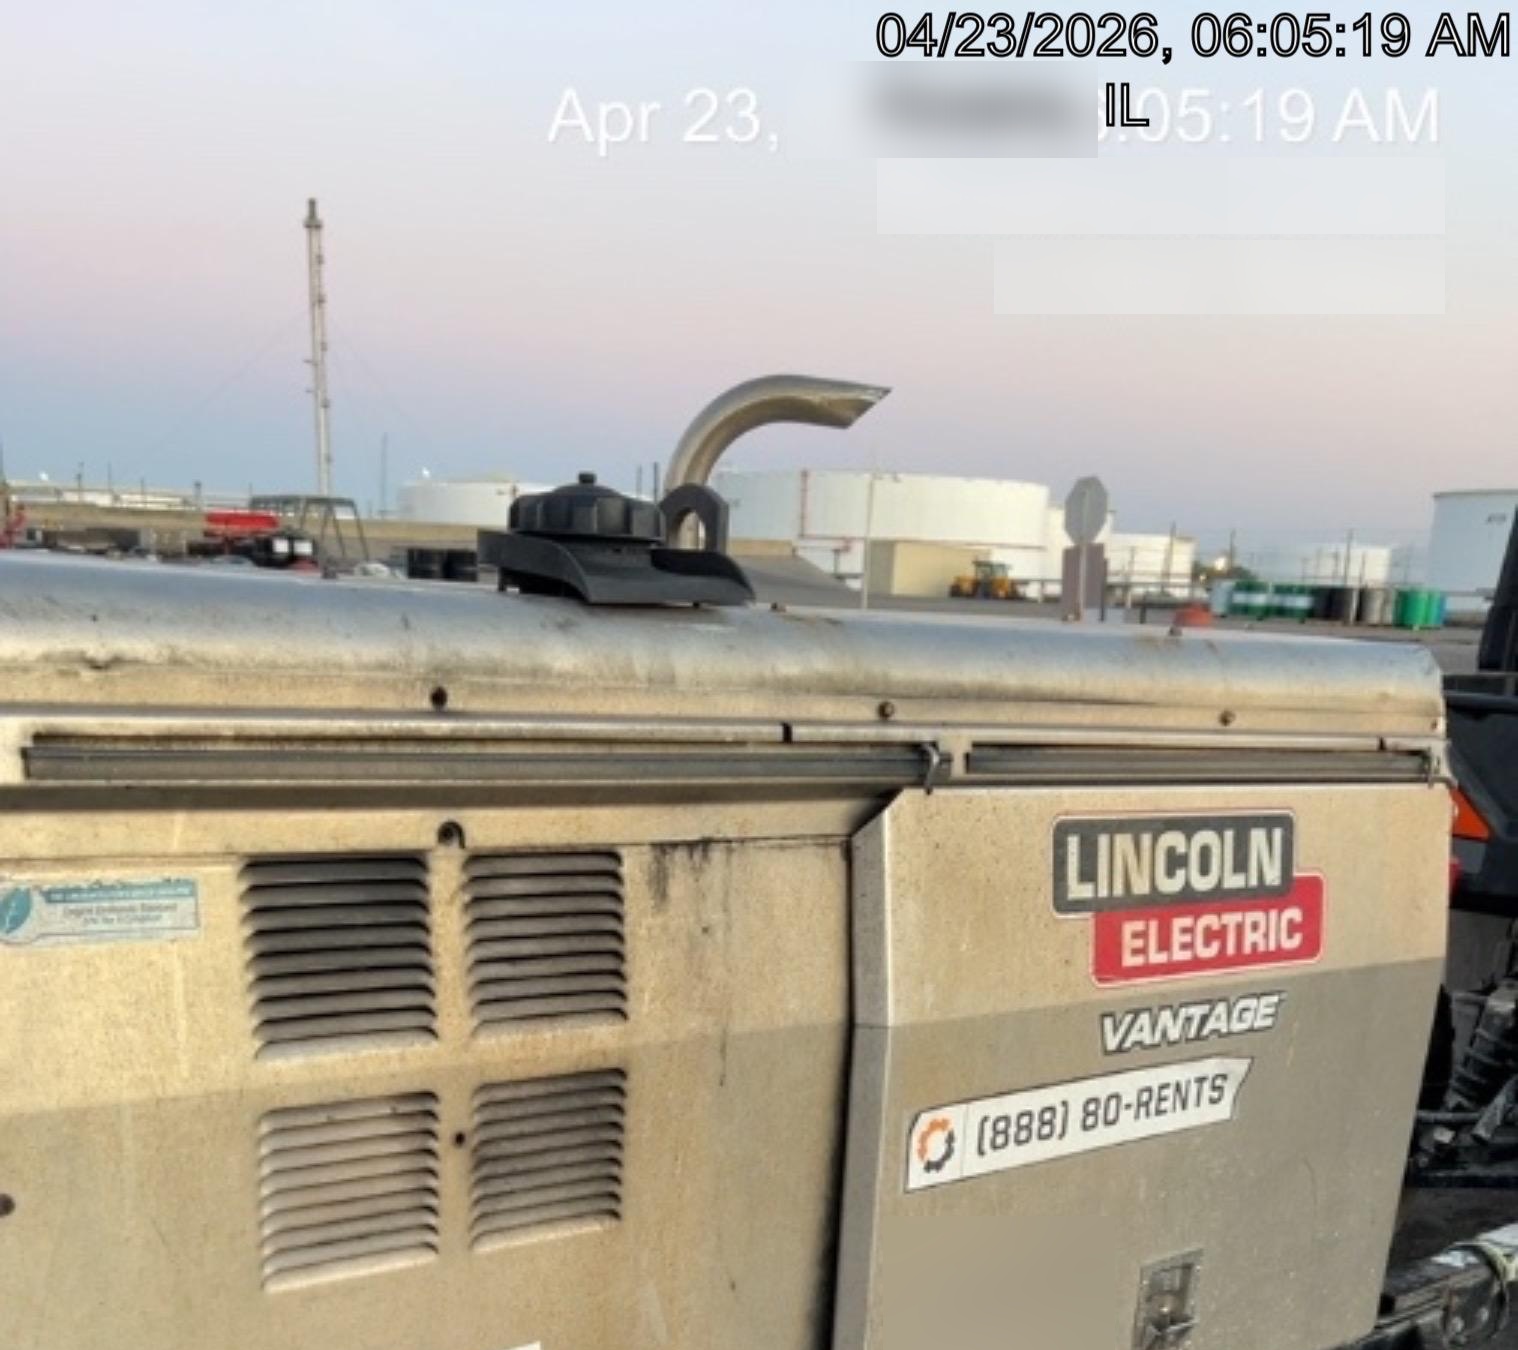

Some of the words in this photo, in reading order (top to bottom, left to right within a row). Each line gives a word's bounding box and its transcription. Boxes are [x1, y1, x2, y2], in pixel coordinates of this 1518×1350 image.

[1066, 827, 1283, 900] LINCOLN
[1120, 906, 1303, 968] ELECTRIC
[1101, 992, 1282, 1054] VANTAGE
[977, 1100, 1070, 1157] (888)
[1080, 1073, 1229, 1132] 80-RENTS
